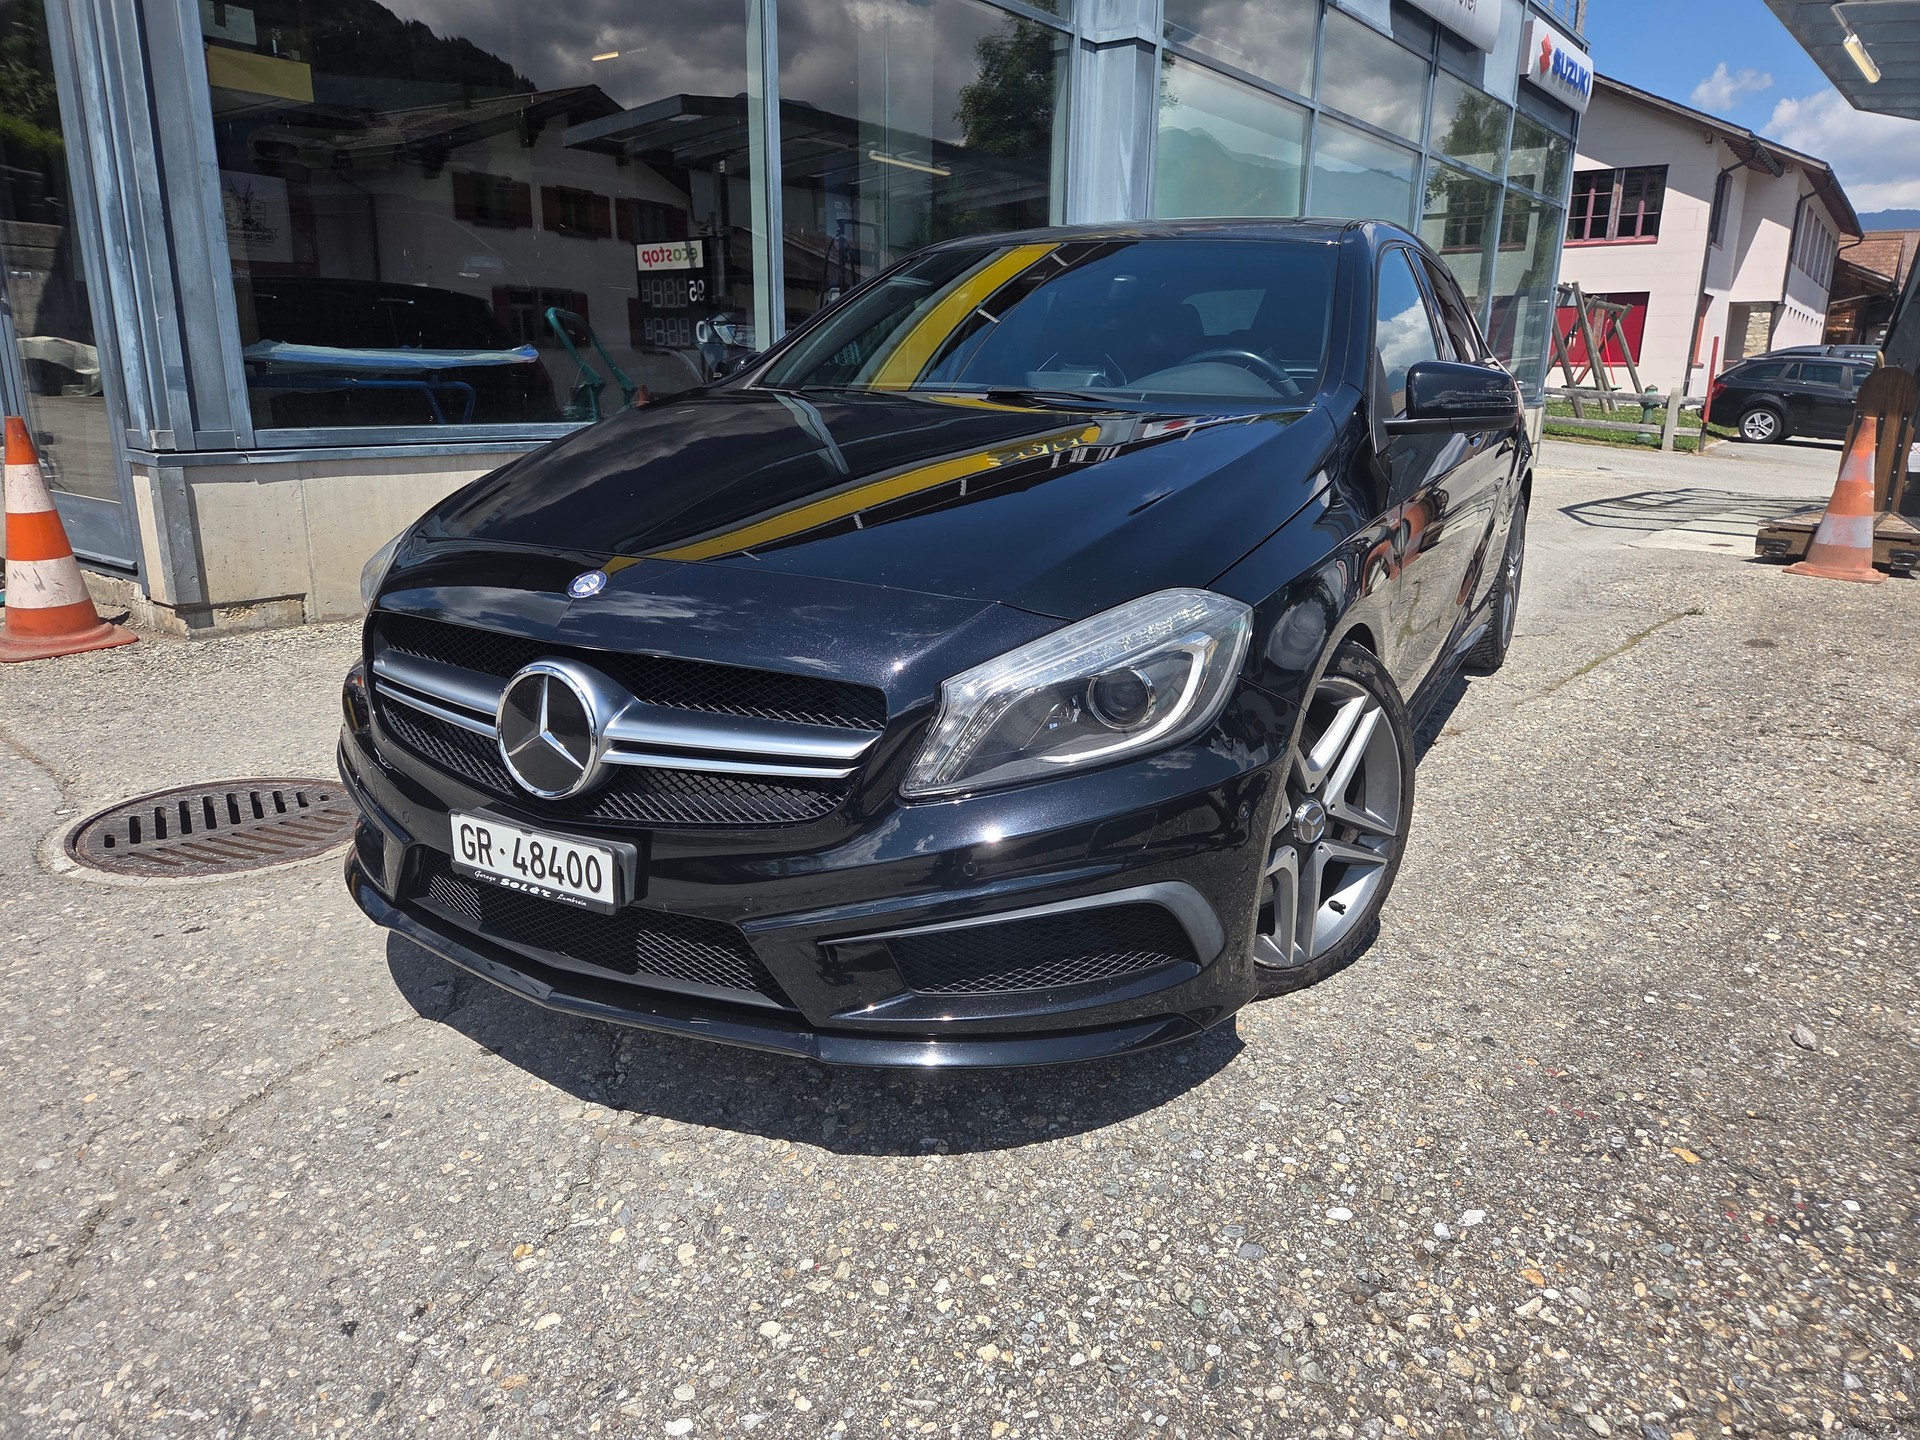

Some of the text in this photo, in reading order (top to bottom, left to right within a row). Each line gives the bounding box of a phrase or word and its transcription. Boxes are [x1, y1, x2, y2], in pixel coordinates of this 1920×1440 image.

[1551, 47, 1591, 97] SUZUKI
[474, 870, 497, 882] Garage
[512, 837, 602, 894] 48400
